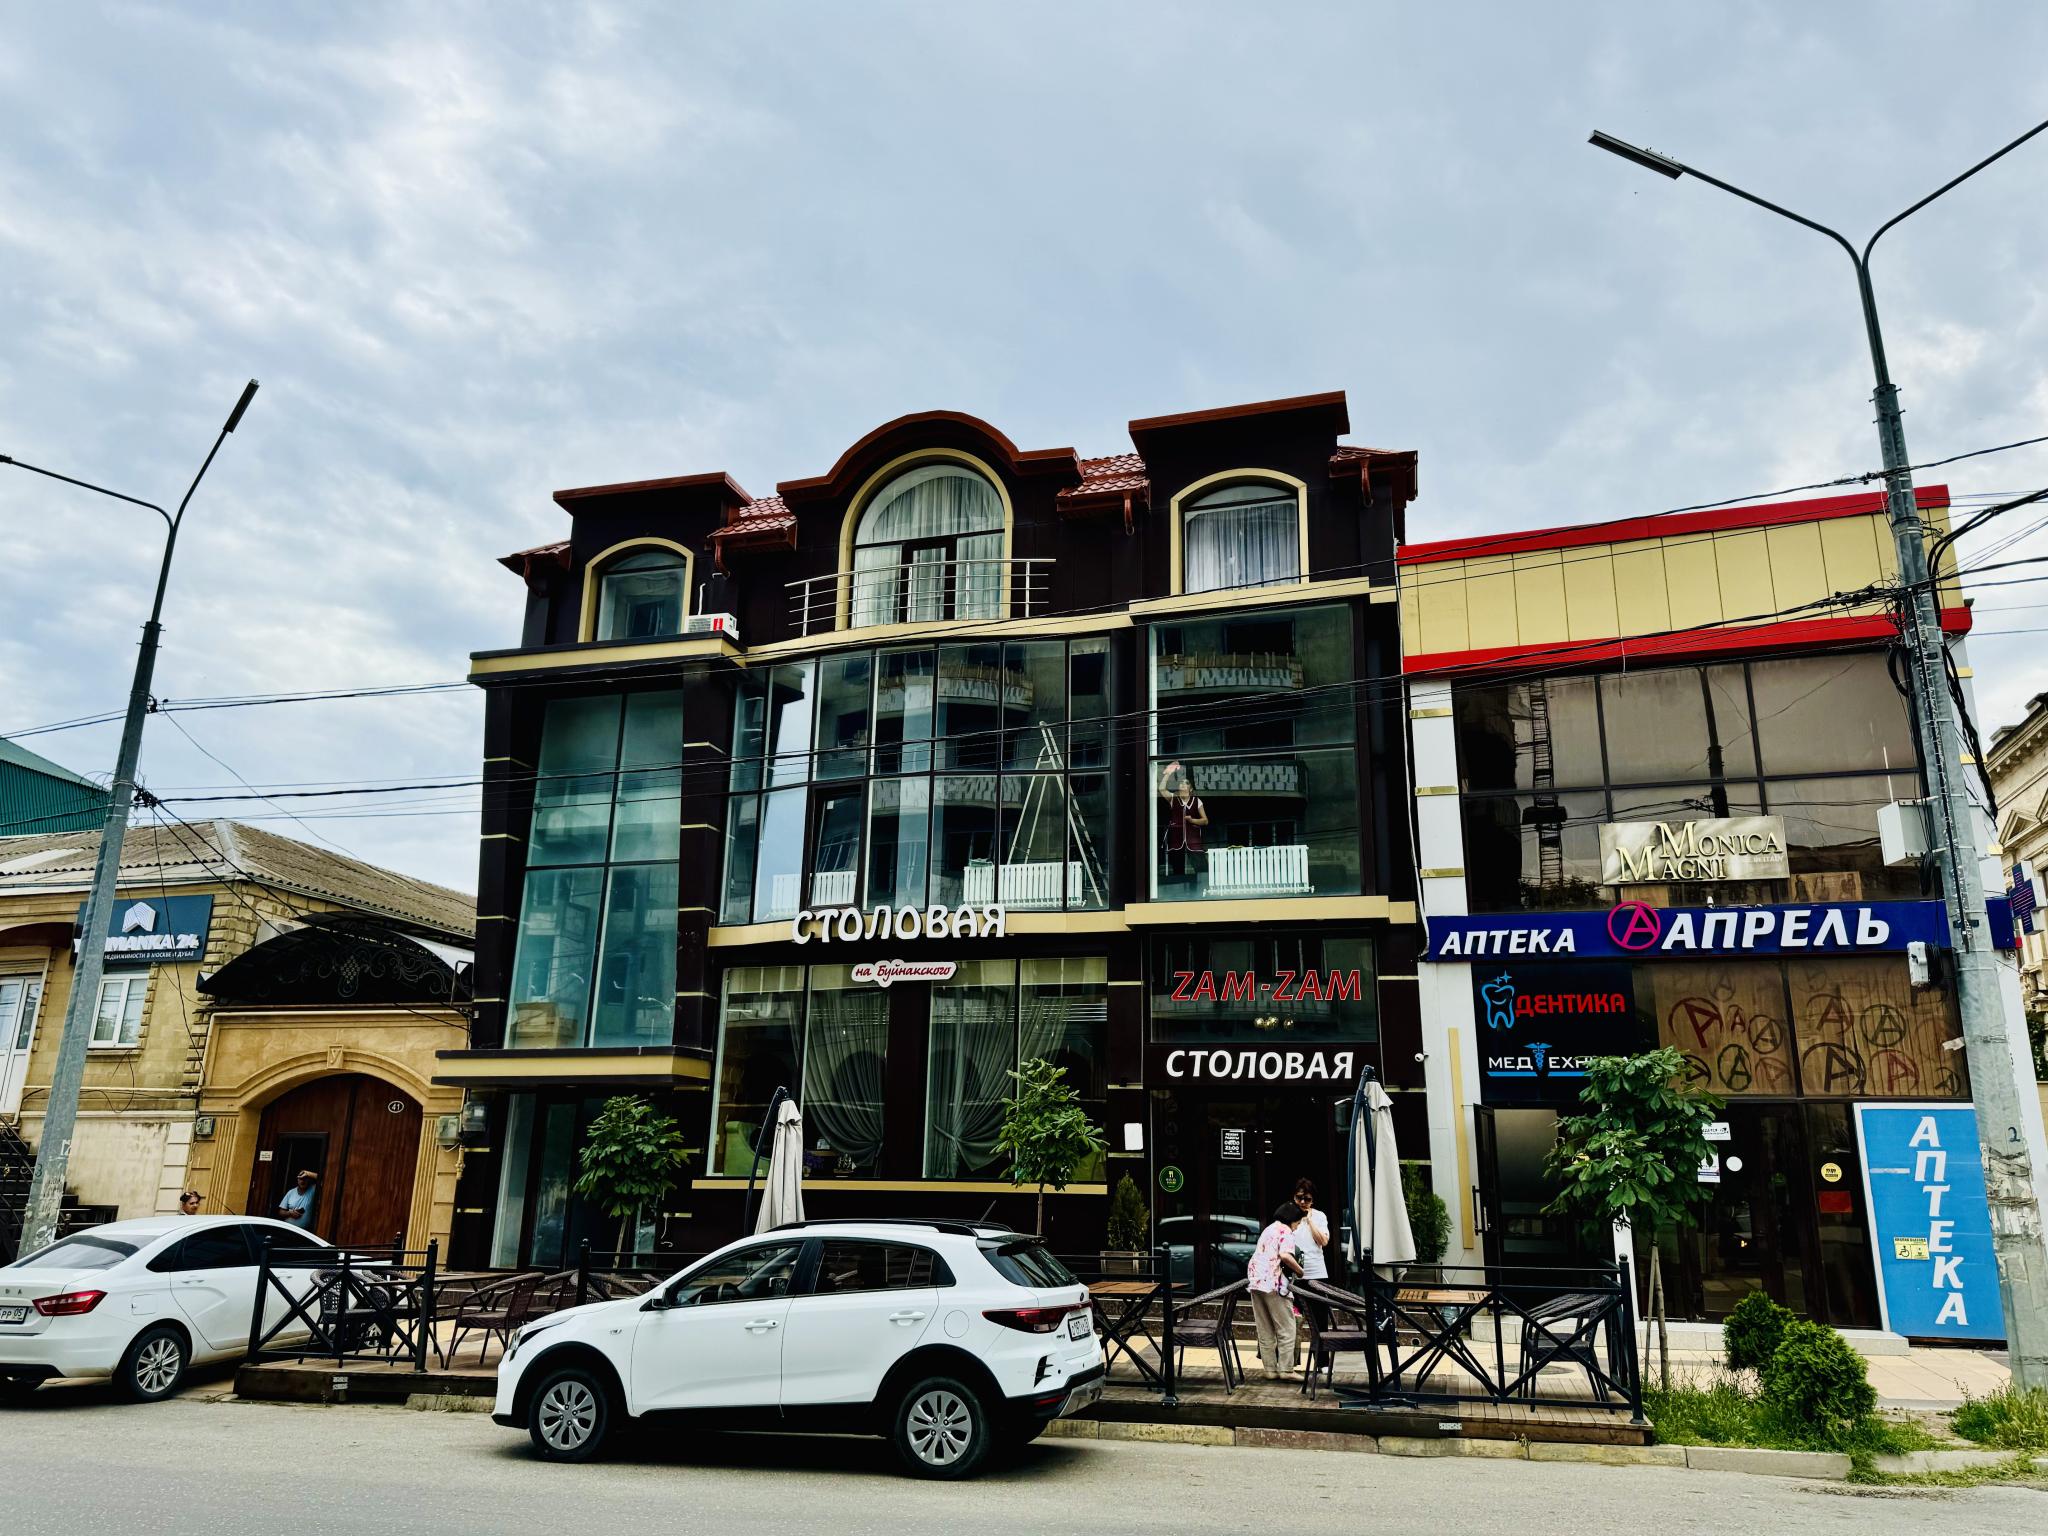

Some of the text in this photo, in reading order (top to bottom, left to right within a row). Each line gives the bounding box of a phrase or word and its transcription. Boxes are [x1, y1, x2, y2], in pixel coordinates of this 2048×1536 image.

[1656, 821, 1783, 859] MONICA
[1616, 845, 1727, 883] MAGNI
[792, 903, 1006, 945] СТОЛОВАЯ
[1661, 907, 1891, 950] АПРЕЛЬ
[177, 934, 199, 949] 24
[1439, 928, 1576, 955] АПТЕКА
[855, 964, 952, 982] на Буйнакского
[1170, 969, 1362, 1001] ZAM-ZAM
[1515, 993, 1626, 1018] ДЕНТИКА
[1166, 1050, 1354, 1080] СТОЛОВАЯ
[391, 1103, 401, 1111] 41
[2008, 1126, 2021, 1143] 2
[1909, 1116, 1969, 1326] АПТЕКА
